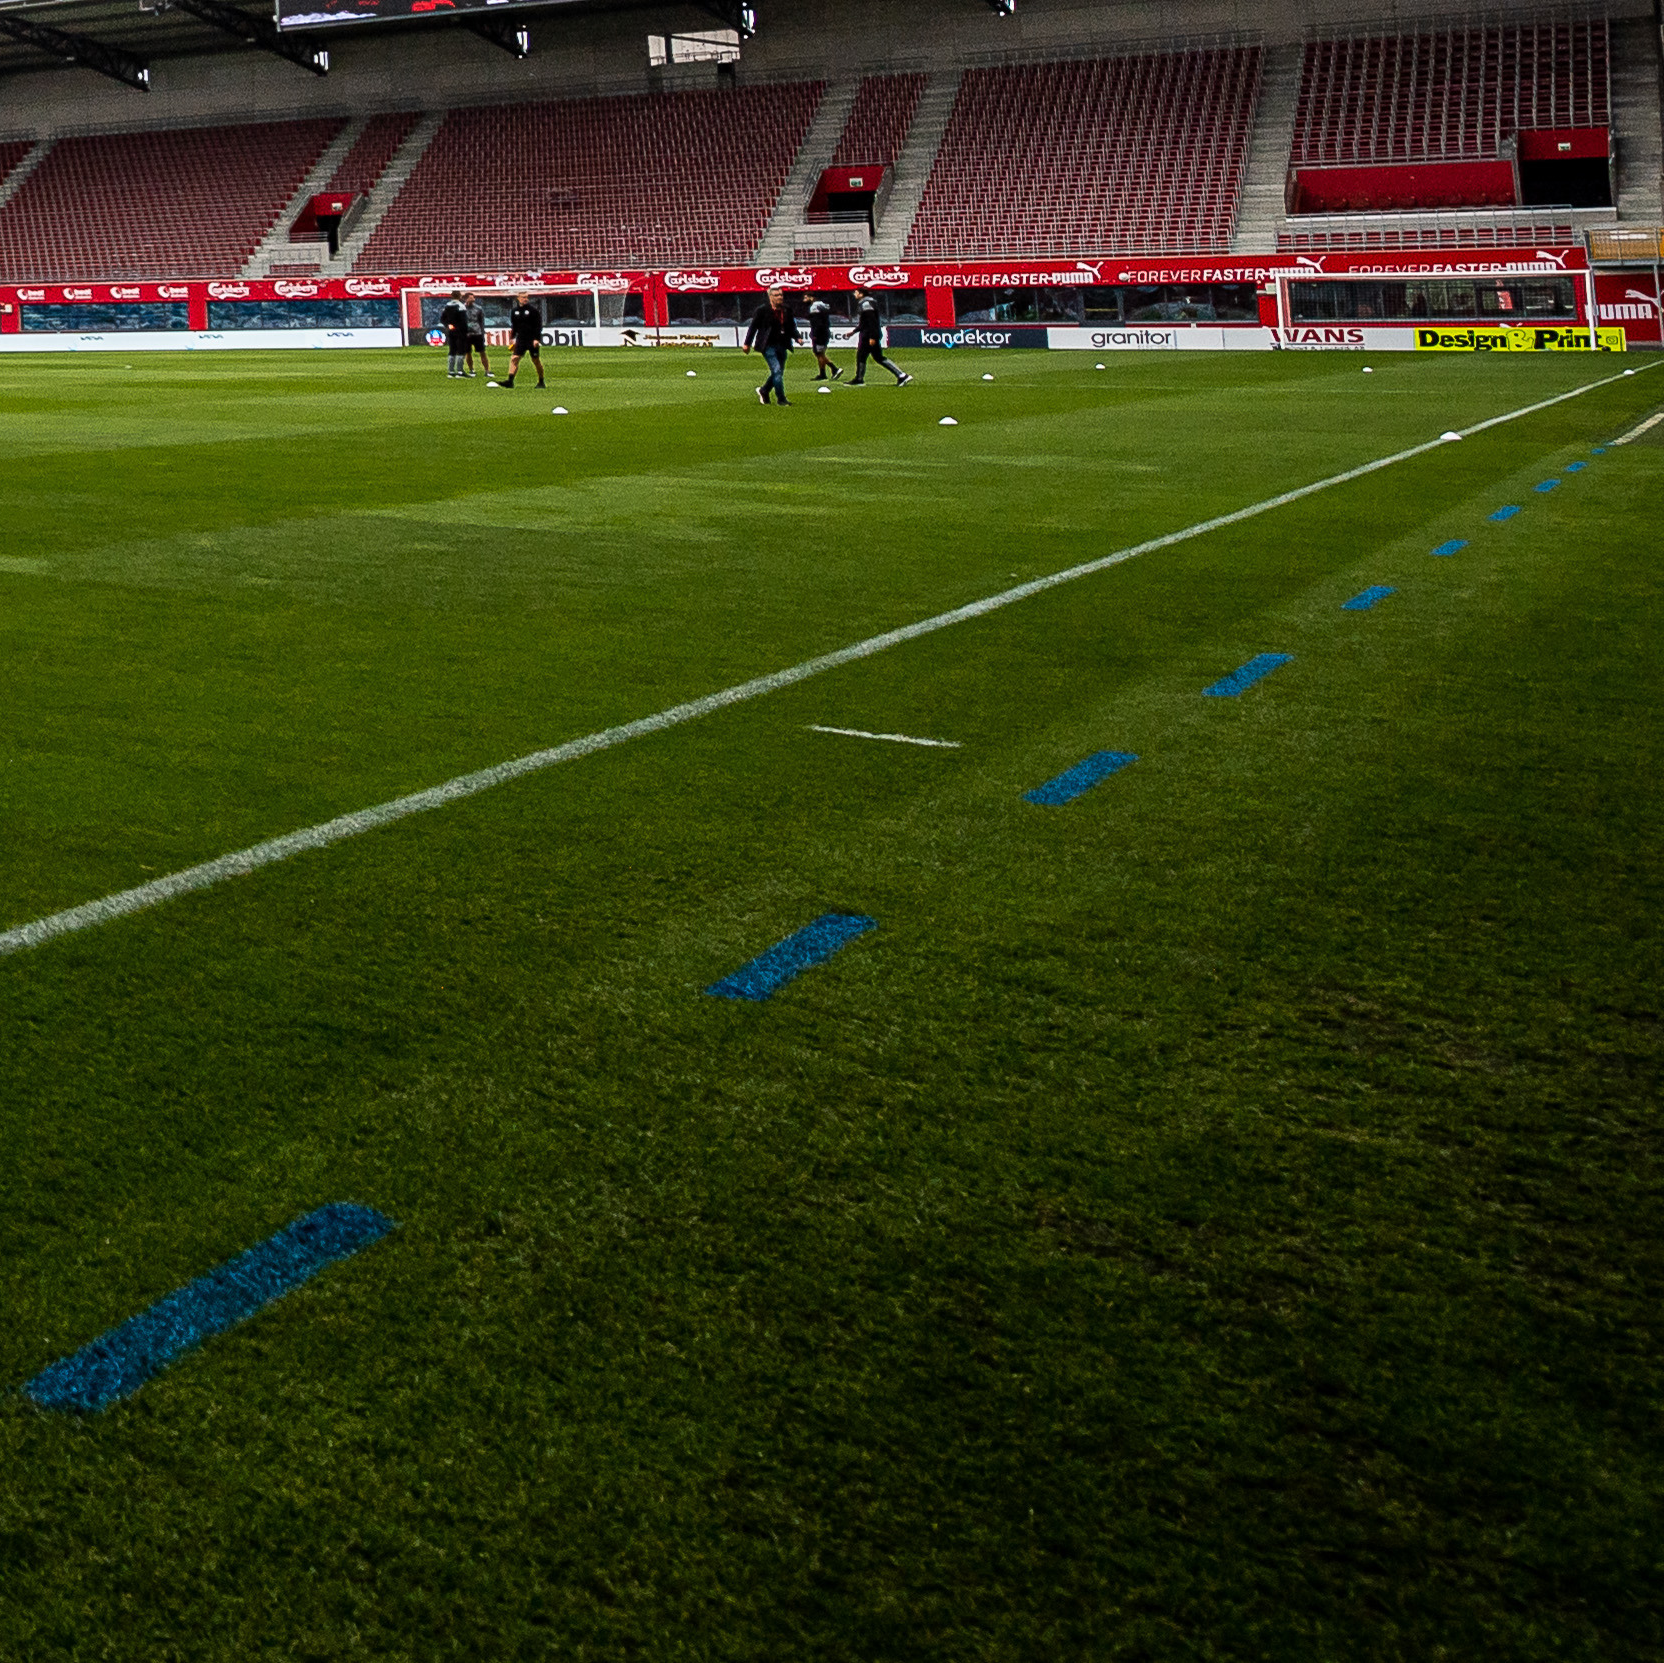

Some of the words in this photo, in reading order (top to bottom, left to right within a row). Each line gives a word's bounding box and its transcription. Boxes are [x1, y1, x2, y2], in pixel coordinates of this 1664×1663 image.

[577, 273, 629, 290] Carlsberg
[664, 270, 719, 290] Carlsberg
[755, 267, 813, 288] Carlsberg
[849, 266, 909, 287] Carlsberg
[924, 274, 991, 287] FOREVER
[992, 273, 1048, 286] FASTER
[1127, 270, 1201, 283] FOREVER
[1203, 268, 1265, 282] FASTER
[208, 282, 250, 299] Carlsberg
[274, 280, 318, 298] Carlsberg
[345, 279, 392, 297] Carlsberg
[921, 329, 1012, 345] kondektor
[1091, 329, 1171, 347] granitor
